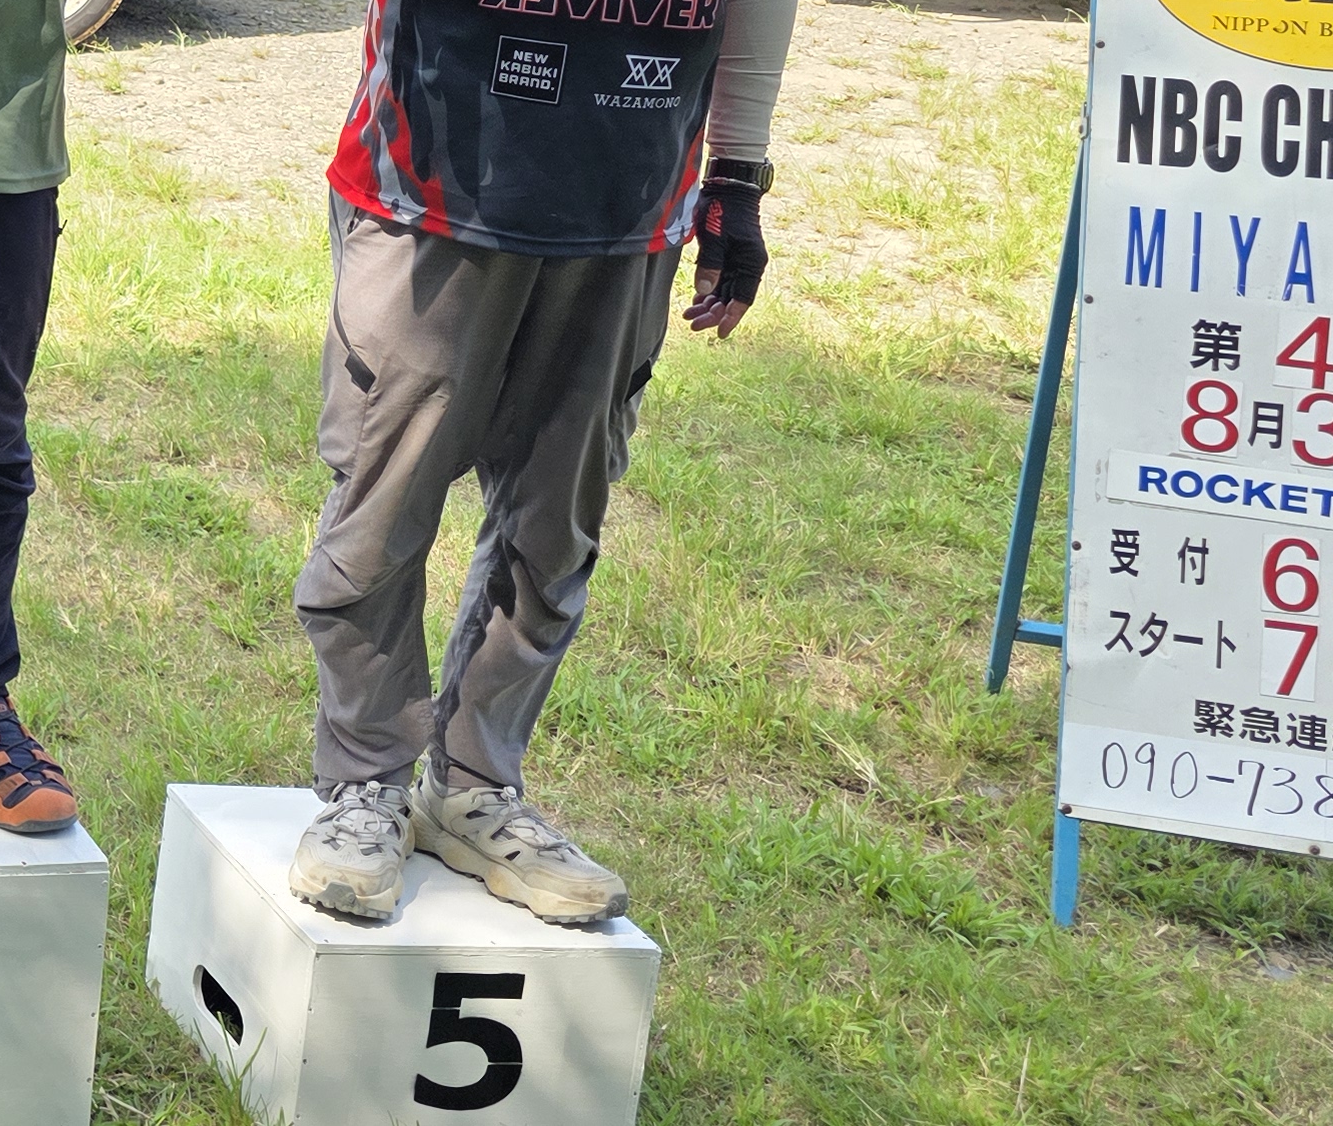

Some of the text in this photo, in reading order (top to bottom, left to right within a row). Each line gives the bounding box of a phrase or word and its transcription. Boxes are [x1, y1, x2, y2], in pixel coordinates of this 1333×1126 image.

[1212, 15, 1308, 36] NIPPON
[498, 72, 556, 91] BRAND.
[500, 60, 558, 79] KABUKI
[513, 49, 549, 65] NEW
[593, 93, 682, 109] WAZAMONO
[1117, 74, 1243, 173] NBC
[1125, 205, 1315, 304] MIYA
[1137, 464, 1333, 518] ROCKET
[1262, 537, 1320, 613] 6
[1104, 609, 1319, 697] スタート 7
[412, 972, 525, 1112] 5
